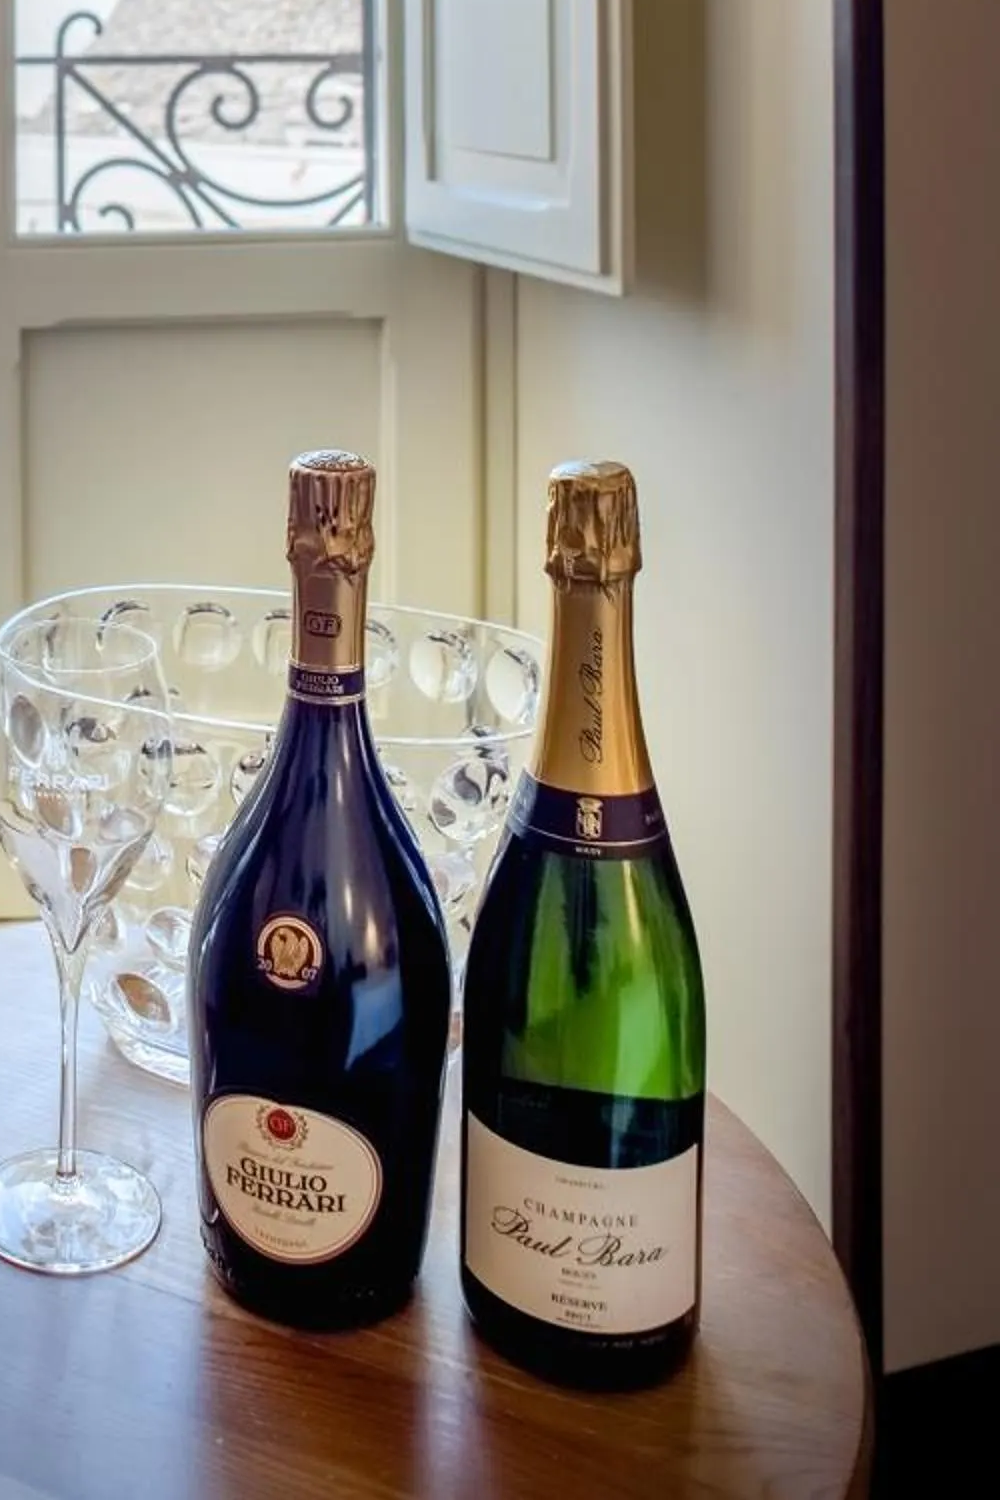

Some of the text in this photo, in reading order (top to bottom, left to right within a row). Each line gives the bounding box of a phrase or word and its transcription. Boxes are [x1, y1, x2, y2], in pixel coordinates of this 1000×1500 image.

[226, 1165, 346, 1213] FERRARI
[241, 1157, 327, 1193] GIULIO
[524, 1197, 639, 1228] CHAMPAGNE
[491, 1205, 666, 1267] Paul Bara
